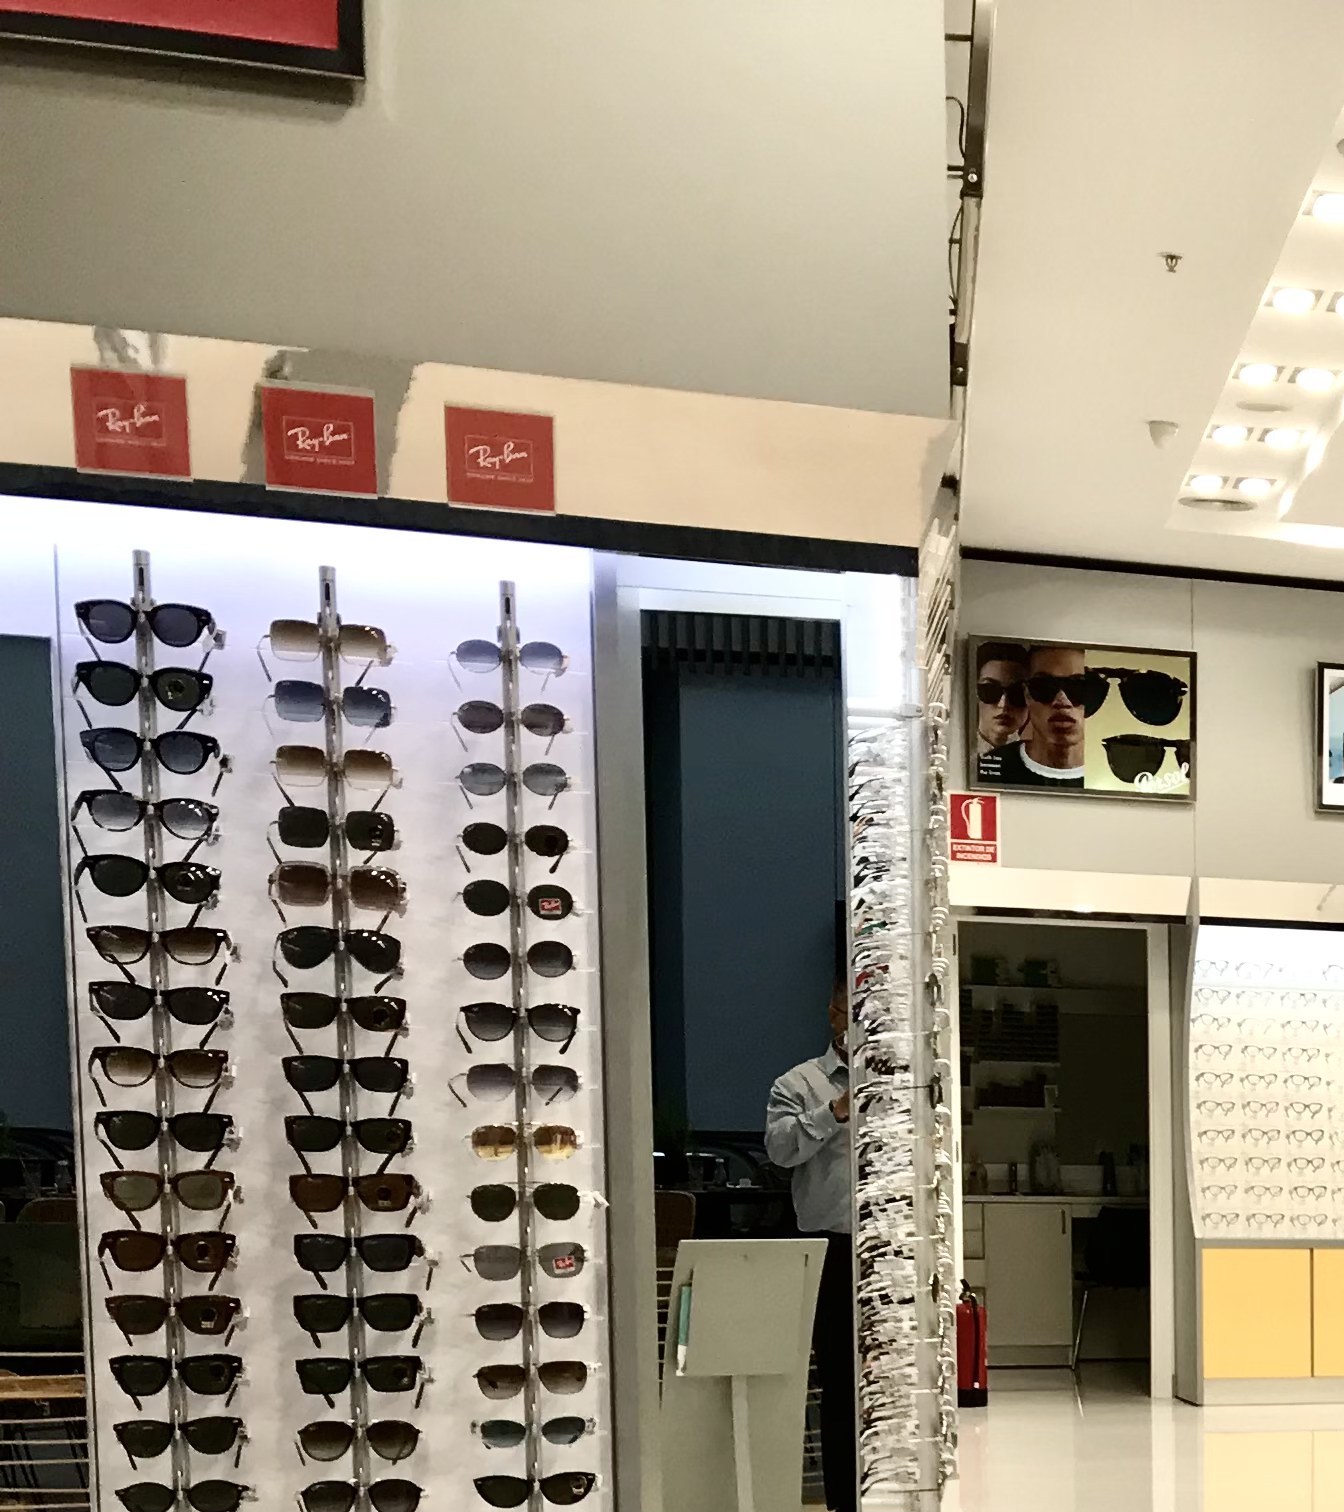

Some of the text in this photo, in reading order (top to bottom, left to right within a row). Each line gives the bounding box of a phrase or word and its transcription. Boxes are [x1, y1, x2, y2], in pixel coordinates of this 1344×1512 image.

[97, 401, 159, 432] Ray-Ban
[288, 424, 350, 451] Ray-Ban
[469, 441, 528, 468] Ray-Ban
